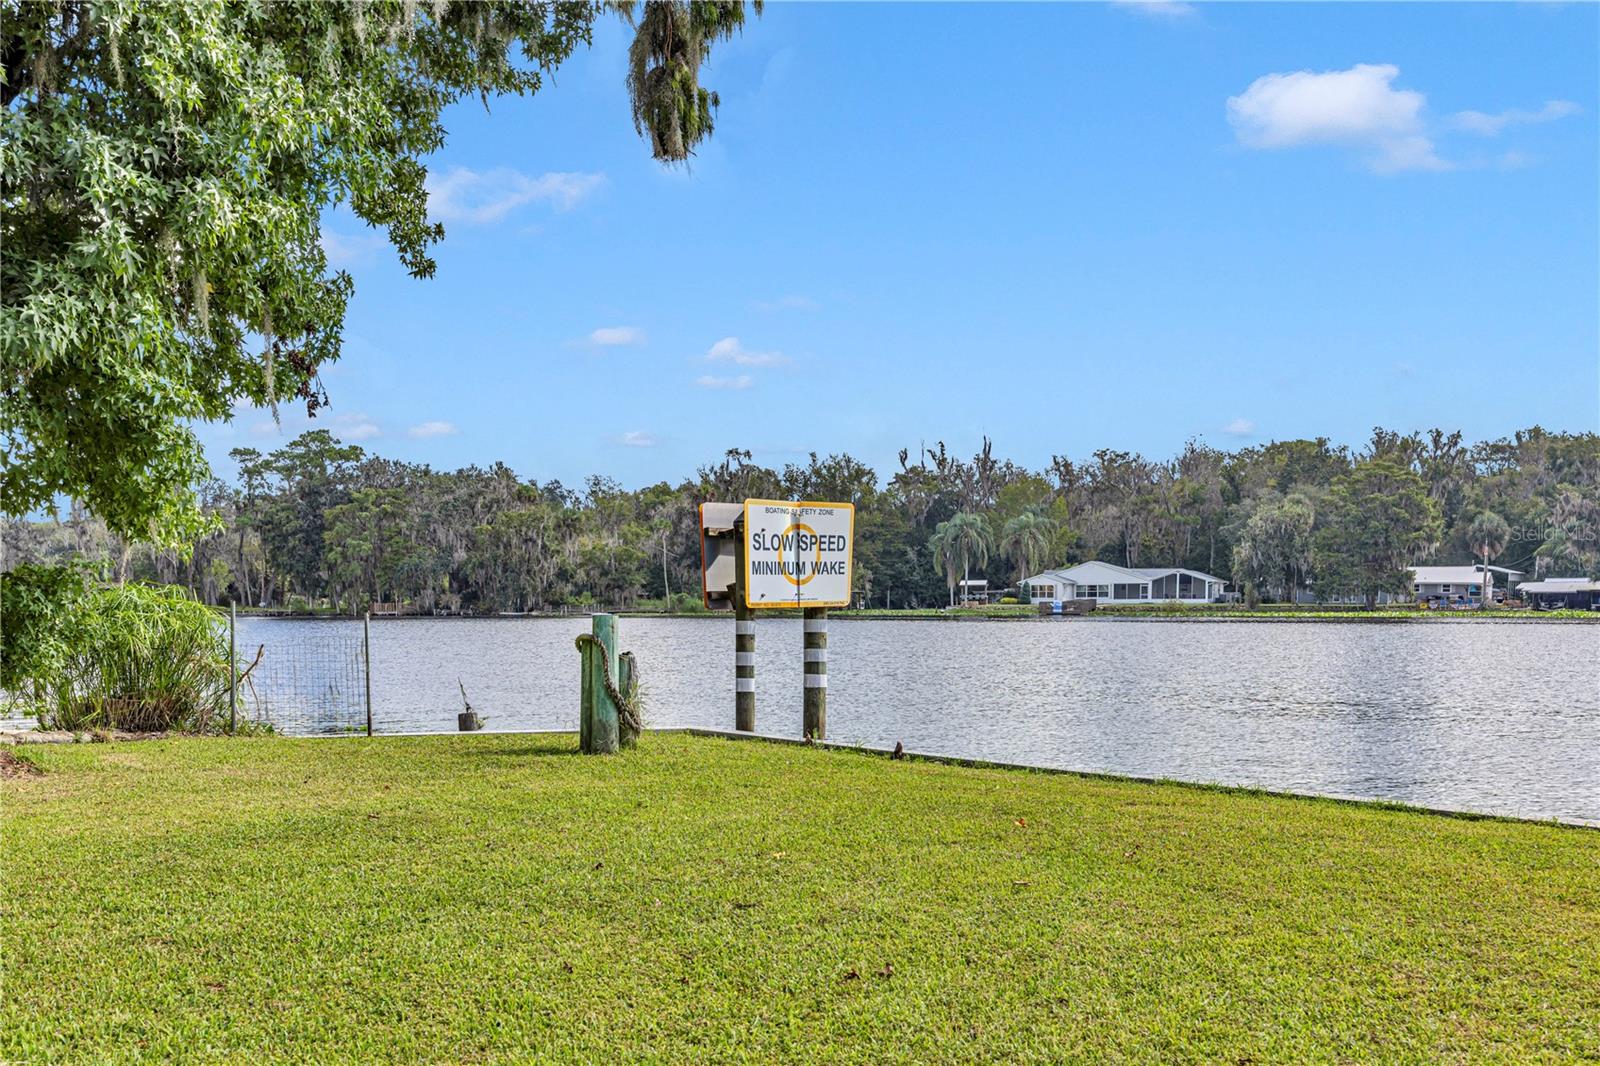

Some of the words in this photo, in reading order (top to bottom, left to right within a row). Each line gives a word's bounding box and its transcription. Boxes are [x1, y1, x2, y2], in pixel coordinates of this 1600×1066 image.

[765, 506, 789, 515] BOATING
[818, 508, 834, 516] ZONE
[752, 533, 794, 551] SLOW
[799, 534, 846, 552] SPEED
[752, 561, 806, 575] MINIMUM
[811, 561, 846, 575] WAKE
